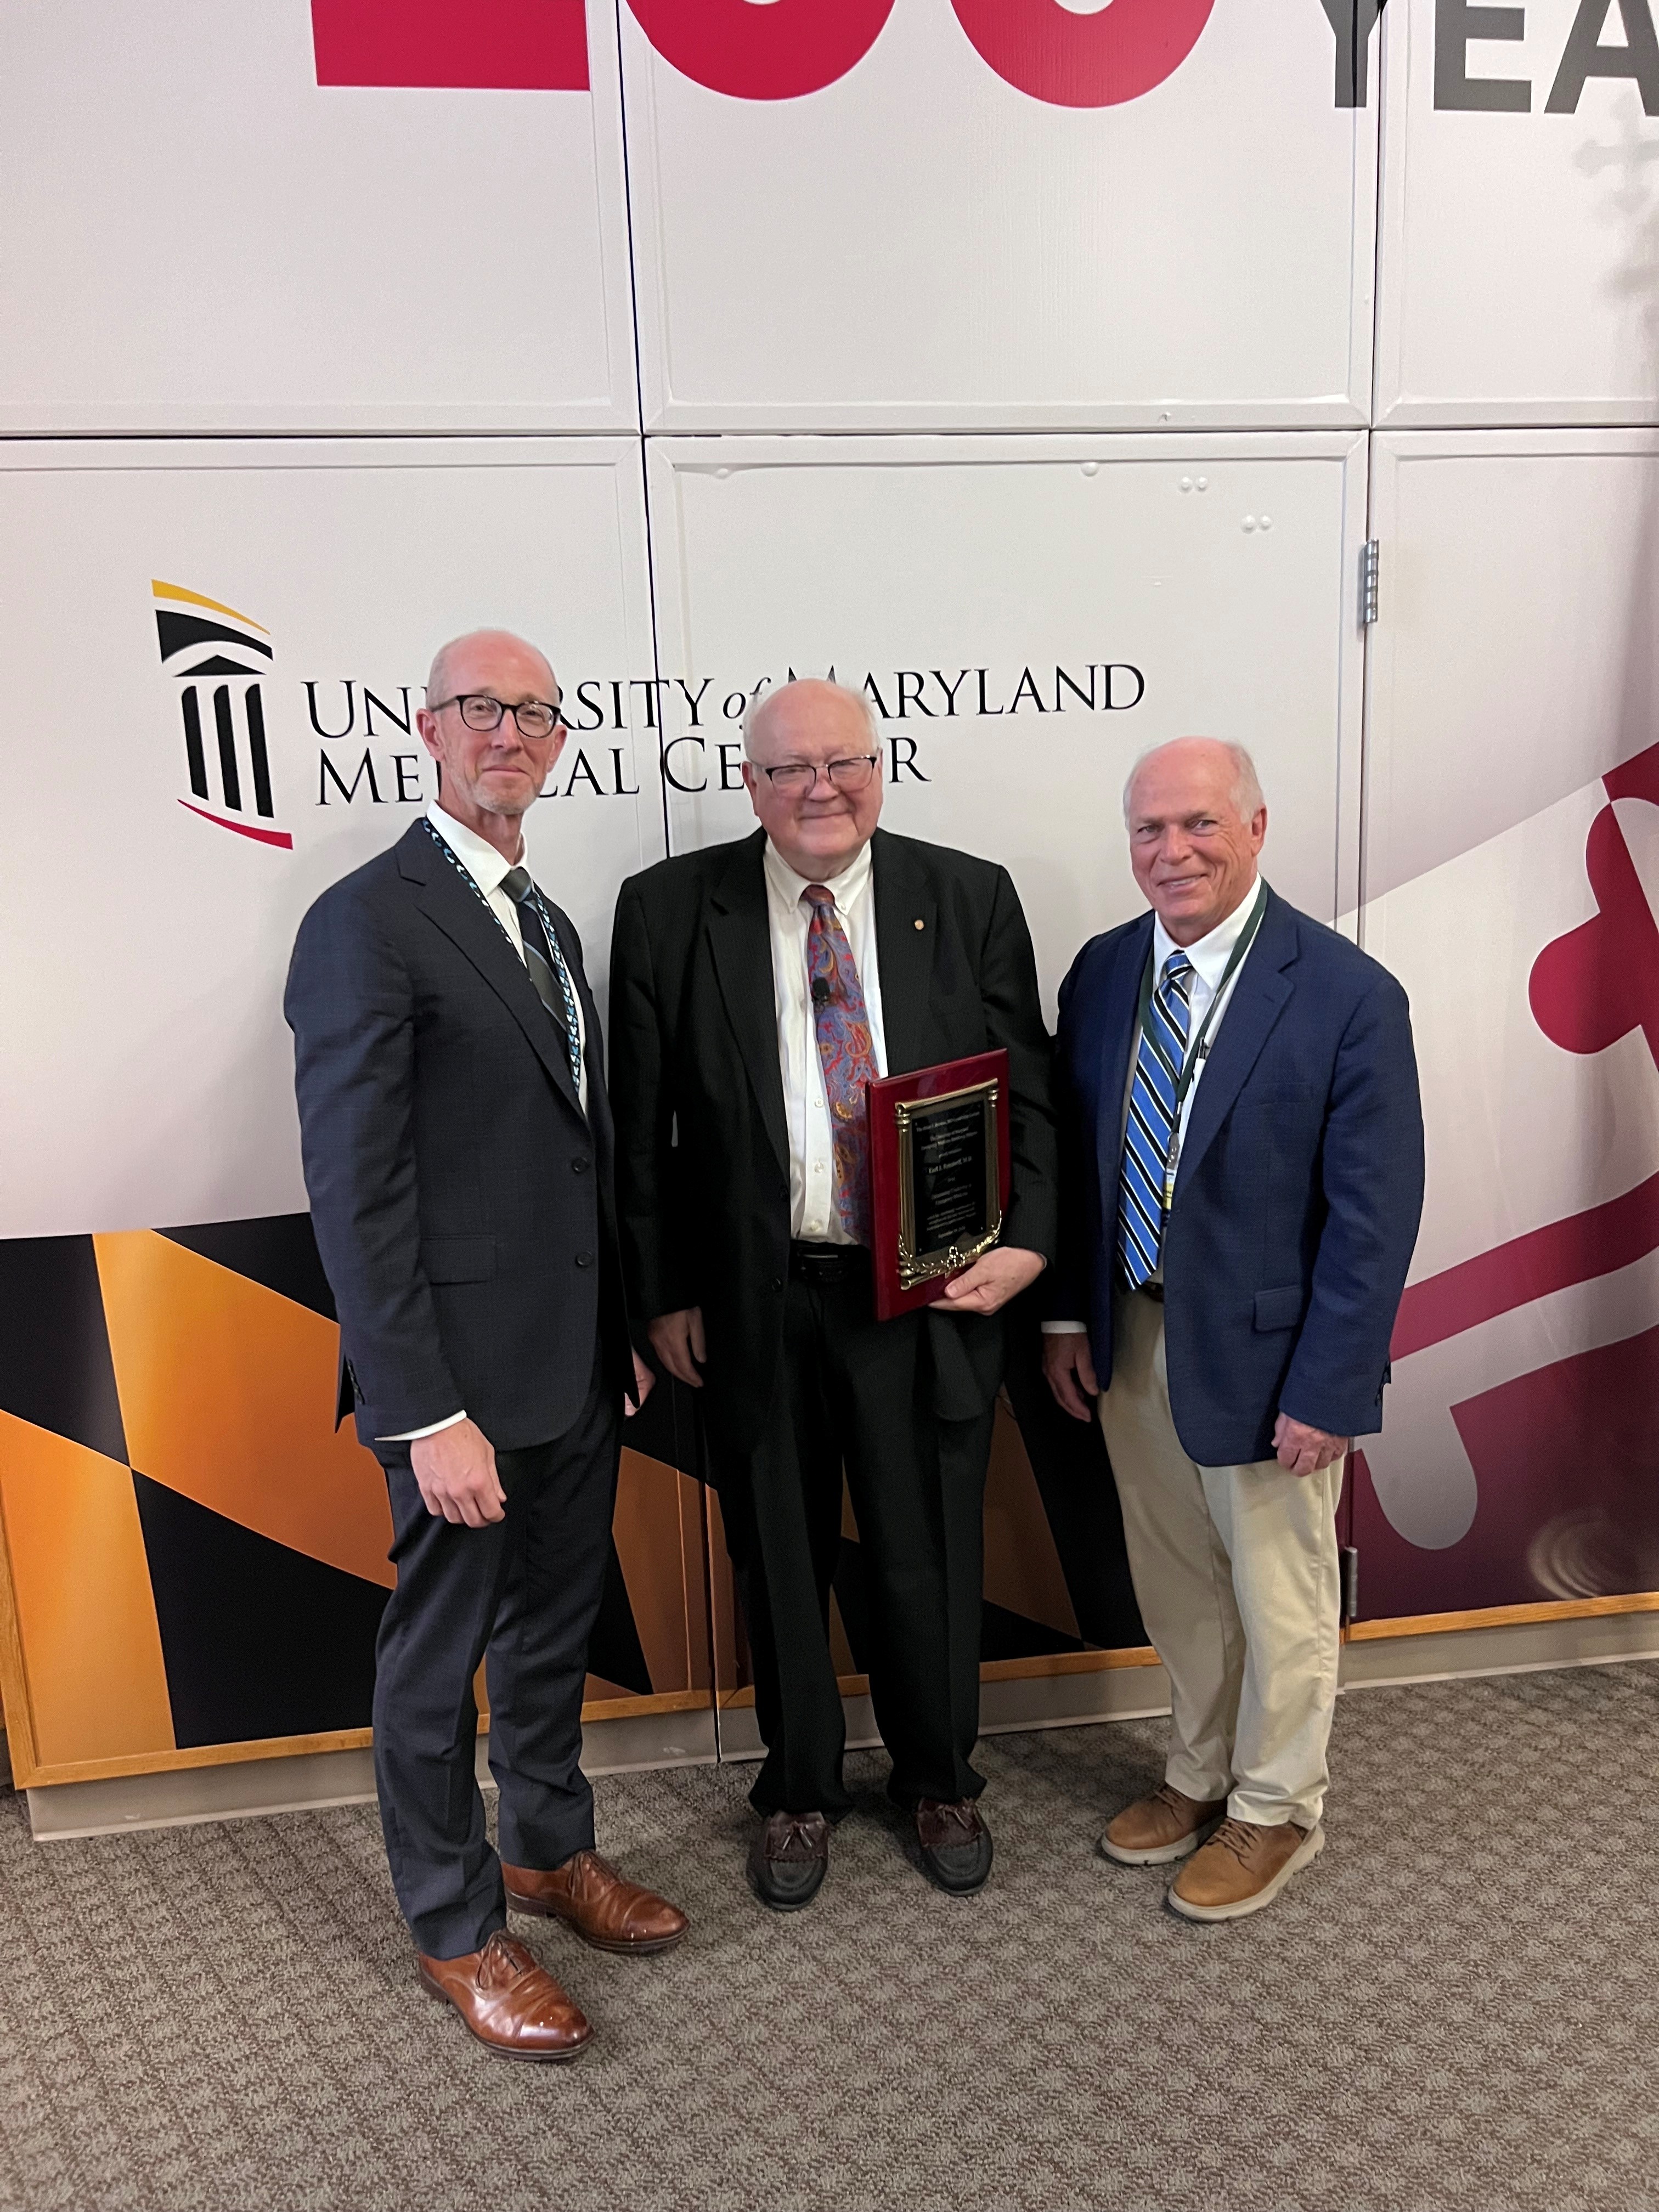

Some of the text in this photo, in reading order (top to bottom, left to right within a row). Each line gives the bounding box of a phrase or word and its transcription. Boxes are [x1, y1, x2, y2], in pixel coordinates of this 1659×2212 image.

[300, 678, 714, 738] UNSITY
[788, 664, 1145, 719] ARYLAND
[315, 737, 932, 806] MEAL CER
